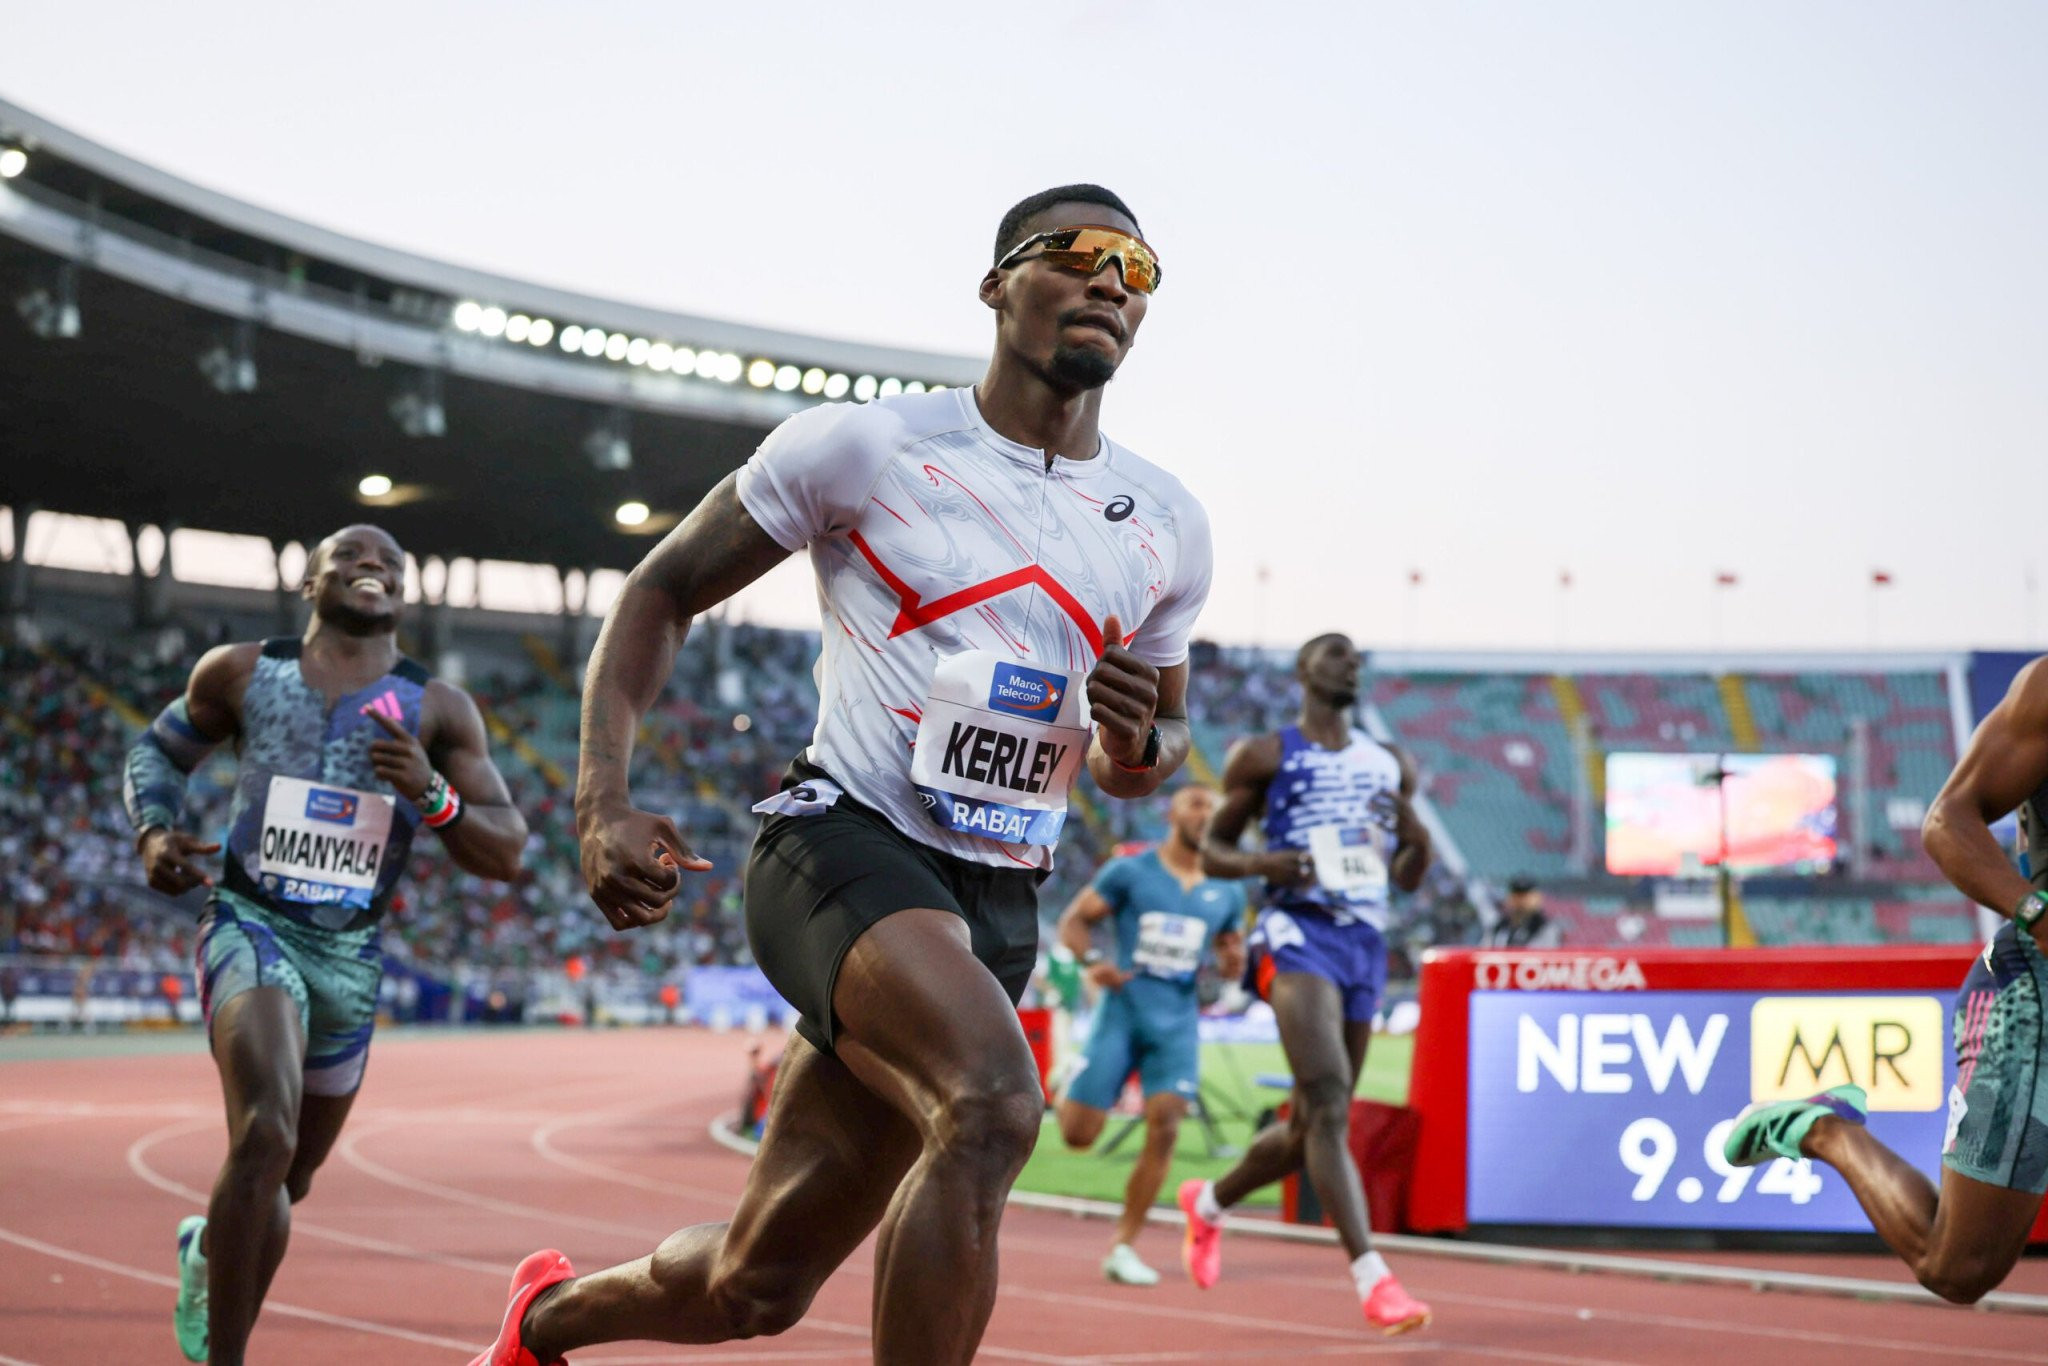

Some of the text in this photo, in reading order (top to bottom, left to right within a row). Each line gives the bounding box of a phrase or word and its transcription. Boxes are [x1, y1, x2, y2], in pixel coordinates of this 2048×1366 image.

[997, 684, 1041, 704] Telecom
[1009, 675, 1044, 692] Maroc
[941, 721, 1067, 794] KERLEY
[953, 802, 1032, 837] RABAT
[263, 826, 379, 877] OMANYALA
[283, 879, 347, 902] RABAT
[1515, 957, 1648, 990] OMEGA
[1517, 1013, 1913, 1094] NEW MR
[1618, 1118, 1823, 1204] 9.94
